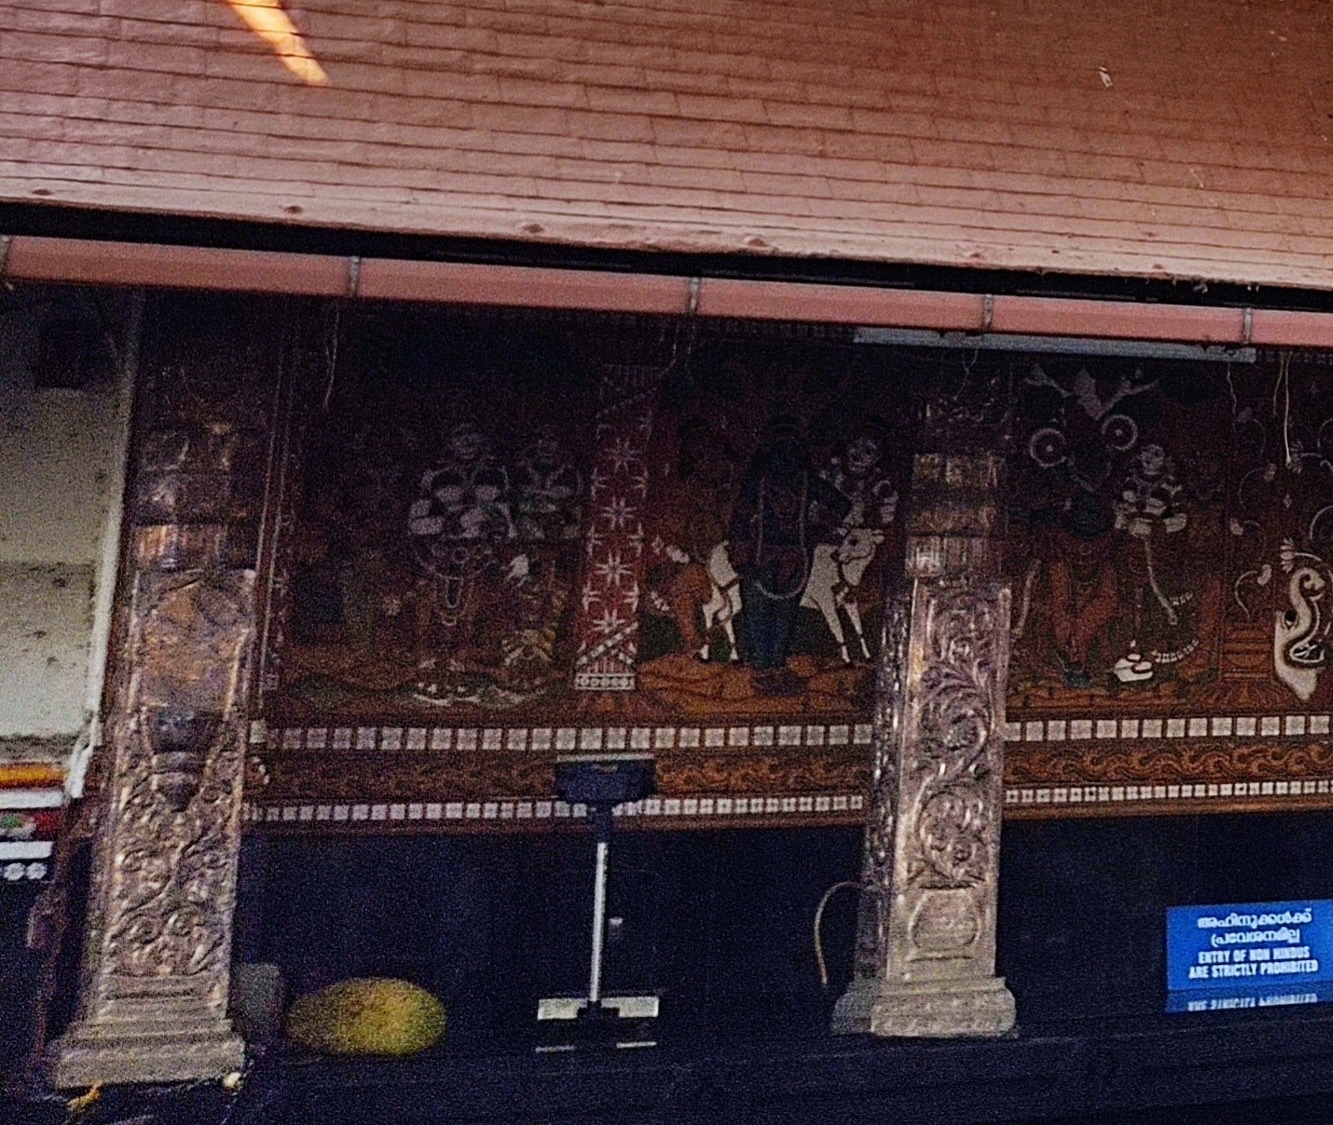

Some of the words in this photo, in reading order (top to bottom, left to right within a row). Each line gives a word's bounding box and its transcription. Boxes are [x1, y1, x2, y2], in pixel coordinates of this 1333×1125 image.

[1199, 950, 1230, 964] ENTRY
[1234, 949, 1246, 963] OF
[1250, 948, 1270, 962] NON
[1274, 946, 1309, 960] HINDUS
[1189, 966, 1208, 979] ARE
[1212, 963, 1257, 977] STRICTLY
[1261, 960, 1318, 975] PROHIBITED
